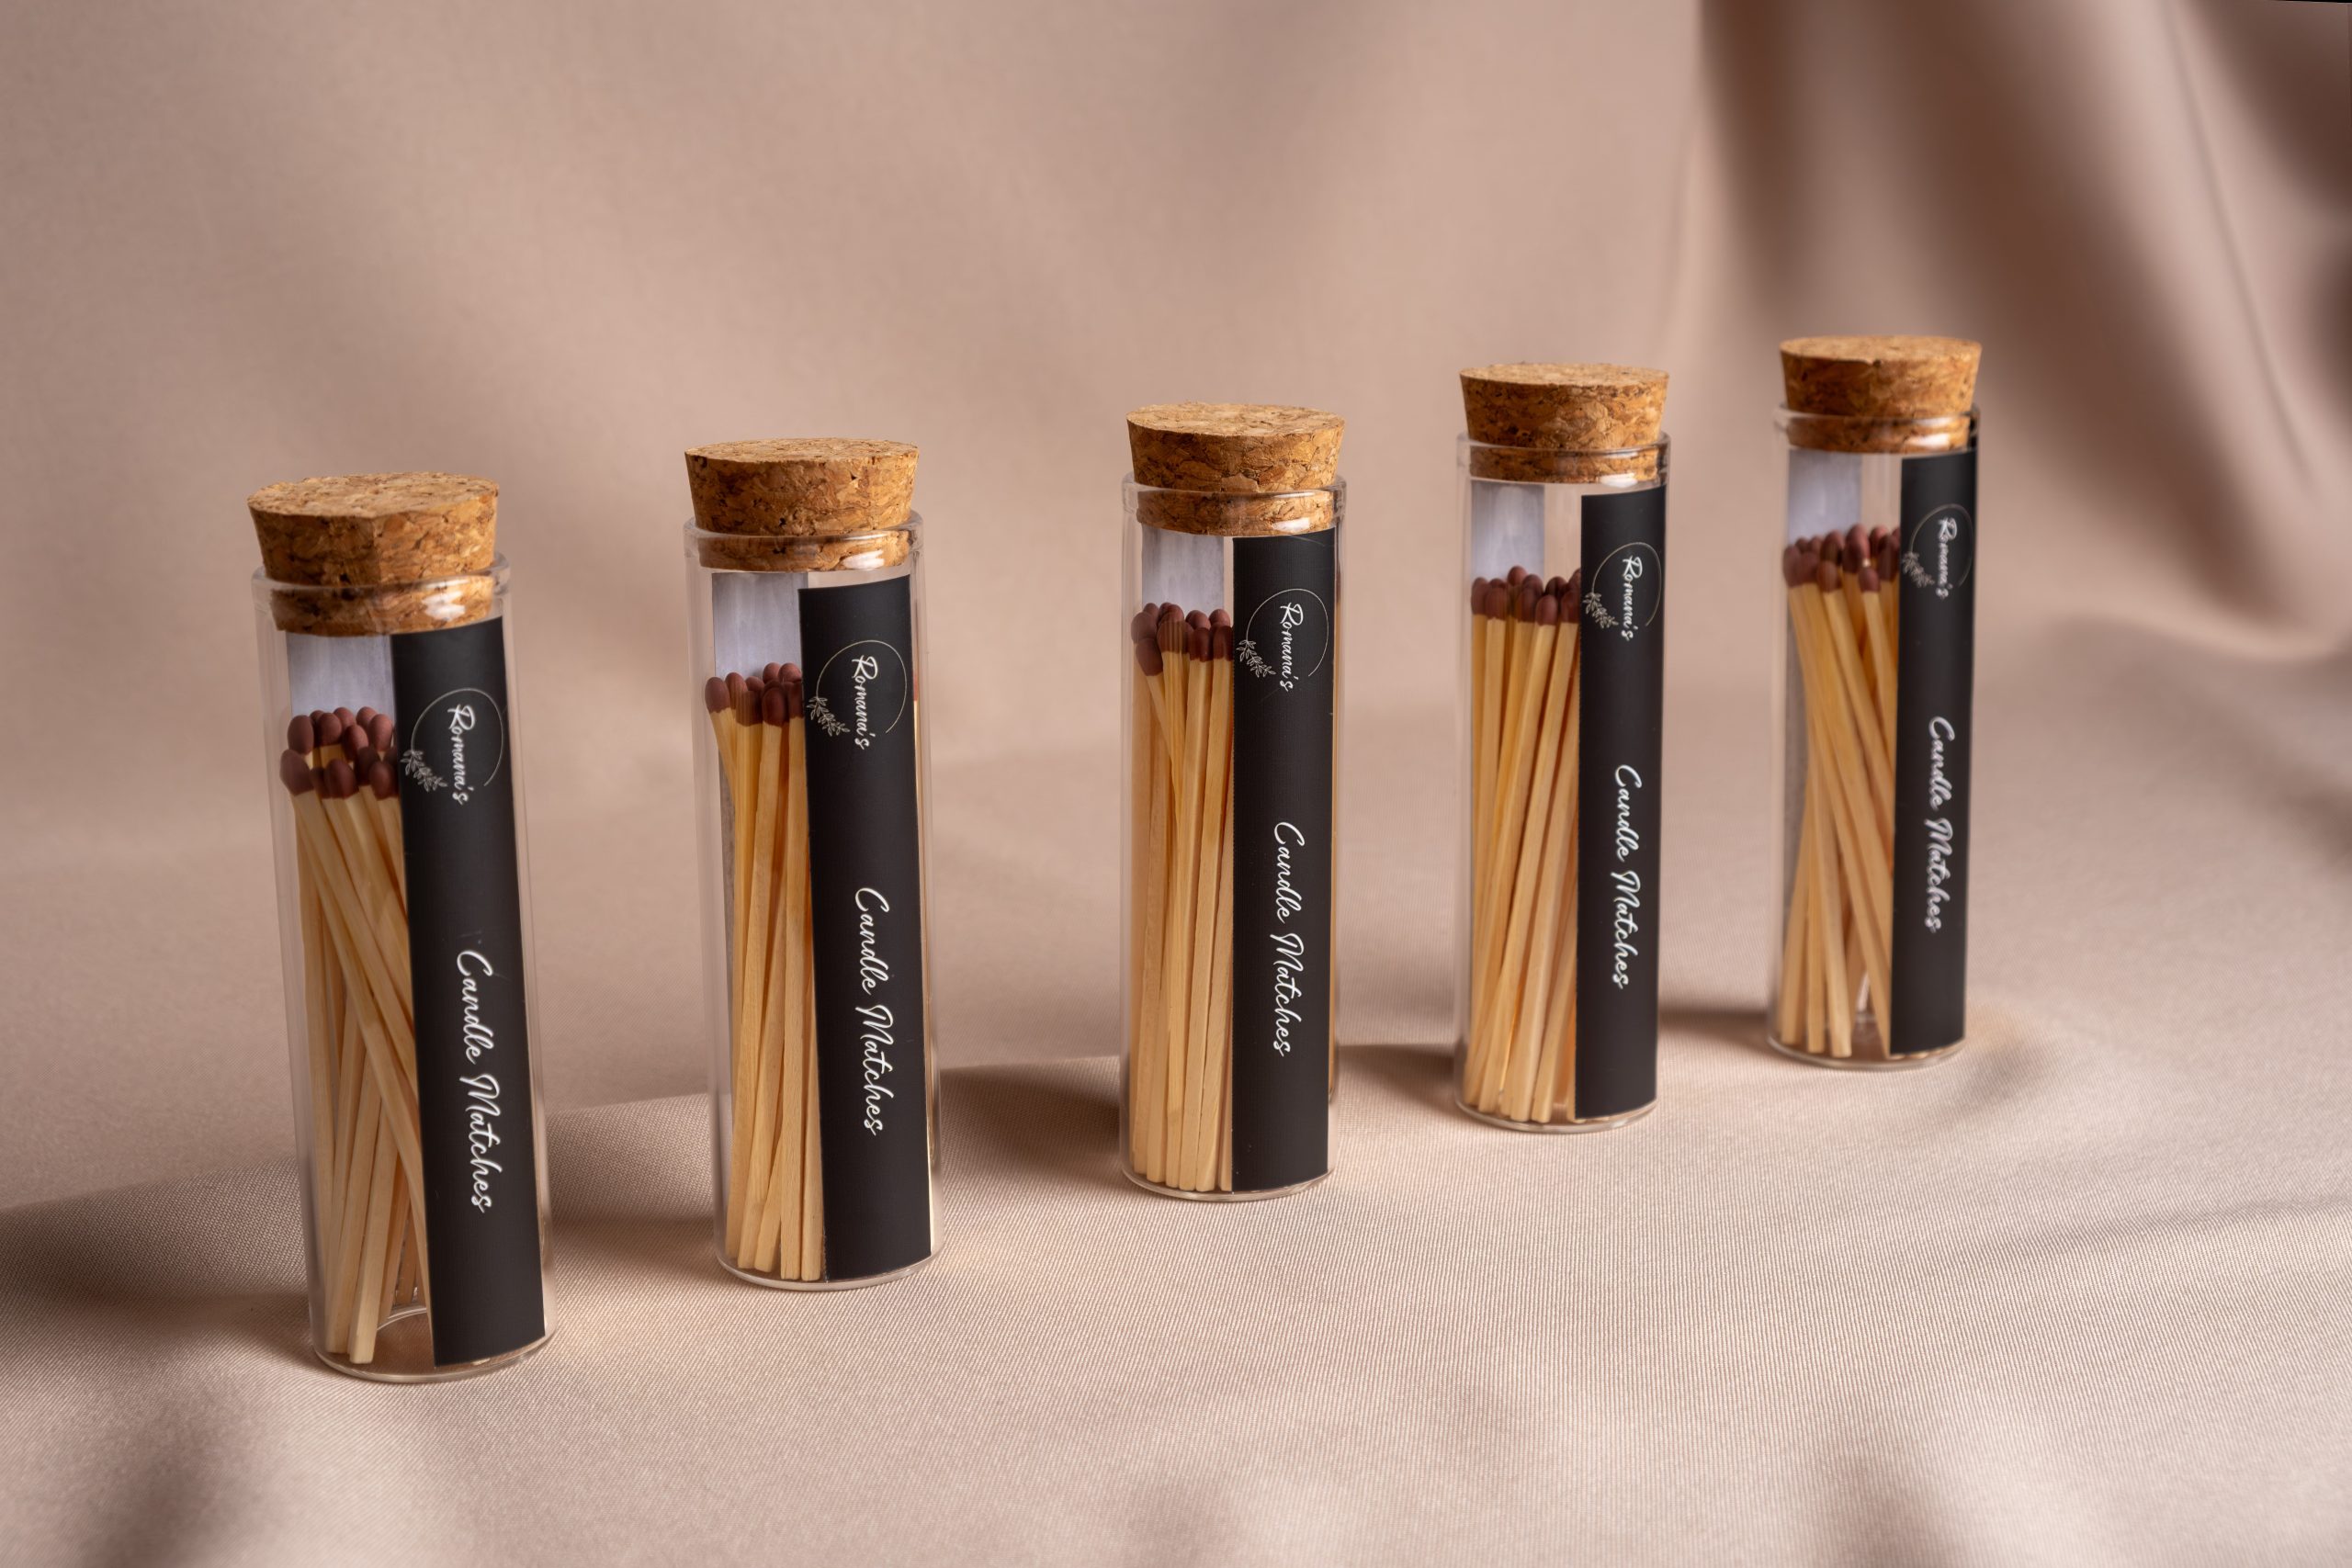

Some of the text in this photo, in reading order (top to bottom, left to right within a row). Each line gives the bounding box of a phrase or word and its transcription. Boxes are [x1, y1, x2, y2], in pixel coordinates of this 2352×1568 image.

[1621, 556, 1643, 641] Romana's
[1935, 517, 1958, 600] Romana's
[850, 654, 878, 750] Romana's
[1278, 602, 1304, 692] Romana's
[447, 704, 476, 805] Romana's
[1924, 716, 1956, 932] Candle Matches
[1270, 821, 1306, 1057] Candle Matches
[1611, 765, 1643, 989] Candle Matches
[456, 950, 503, 1214] Candle Matches
[854, 887, 894, 1136] Candle Matches
